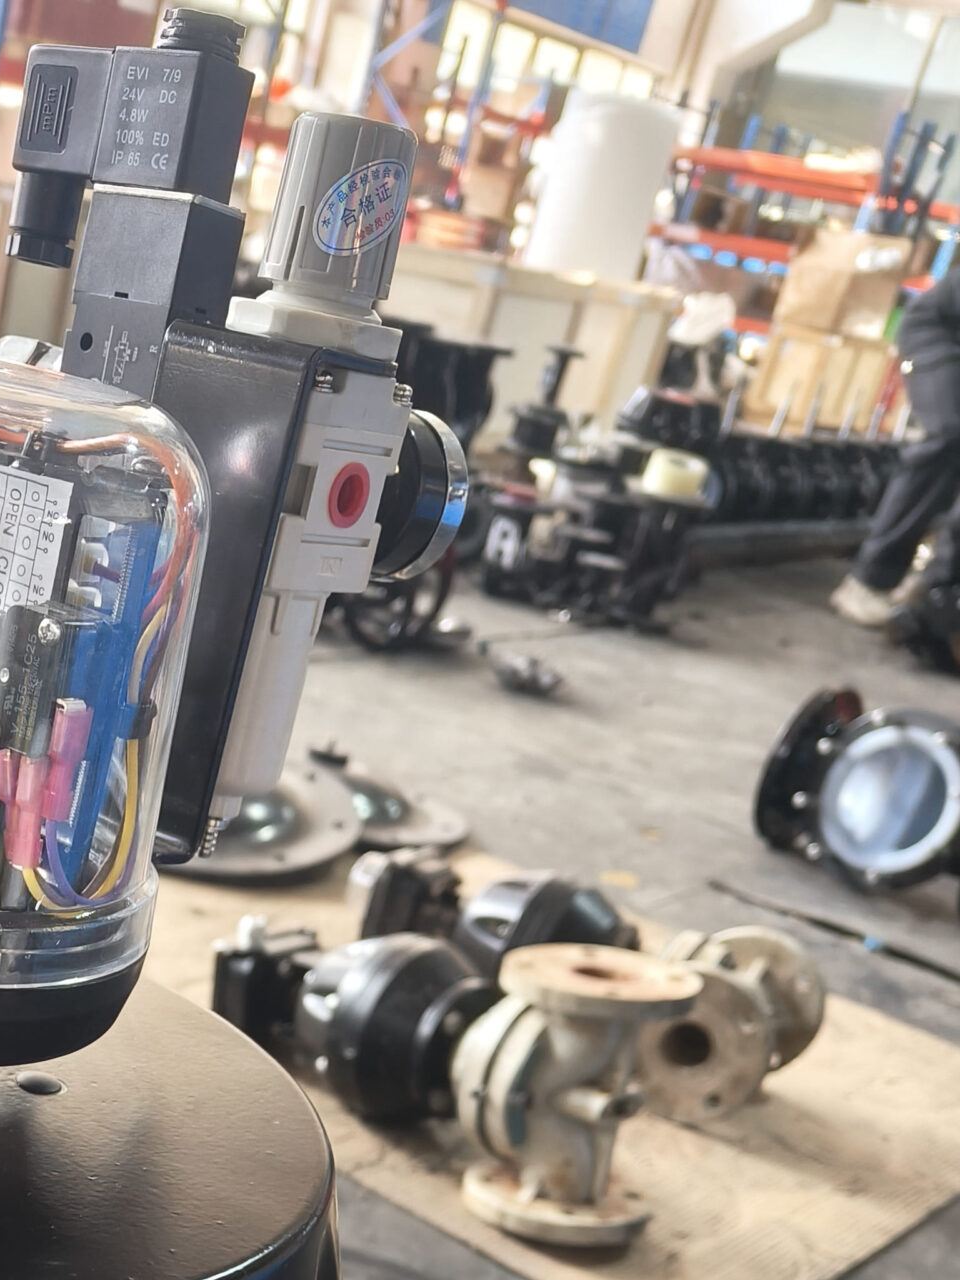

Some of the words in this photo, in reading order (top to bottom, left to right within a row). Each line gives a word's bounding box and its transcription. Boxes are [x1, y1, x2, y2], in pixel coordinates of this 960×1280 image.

[126, 66, 149, 80] EVI
[162, 68, 182, 83] 7/9
[122, 87, 146, 102] 24V
[159, 89, 177, 104] DC
[119, 108, 149, 123] 4.8W
[115, 129, 144, 146] 100%
[152, 131, 170, 147] ED
[111, 150, 124, 165] IP
[127, 151, 140, 166] 65
[340, 181, 393, 228] 合格证
[3, 487, 22, 537] OPEN
[46, 509, 59, 521] NC
[32, 584, 45, 597] NC
